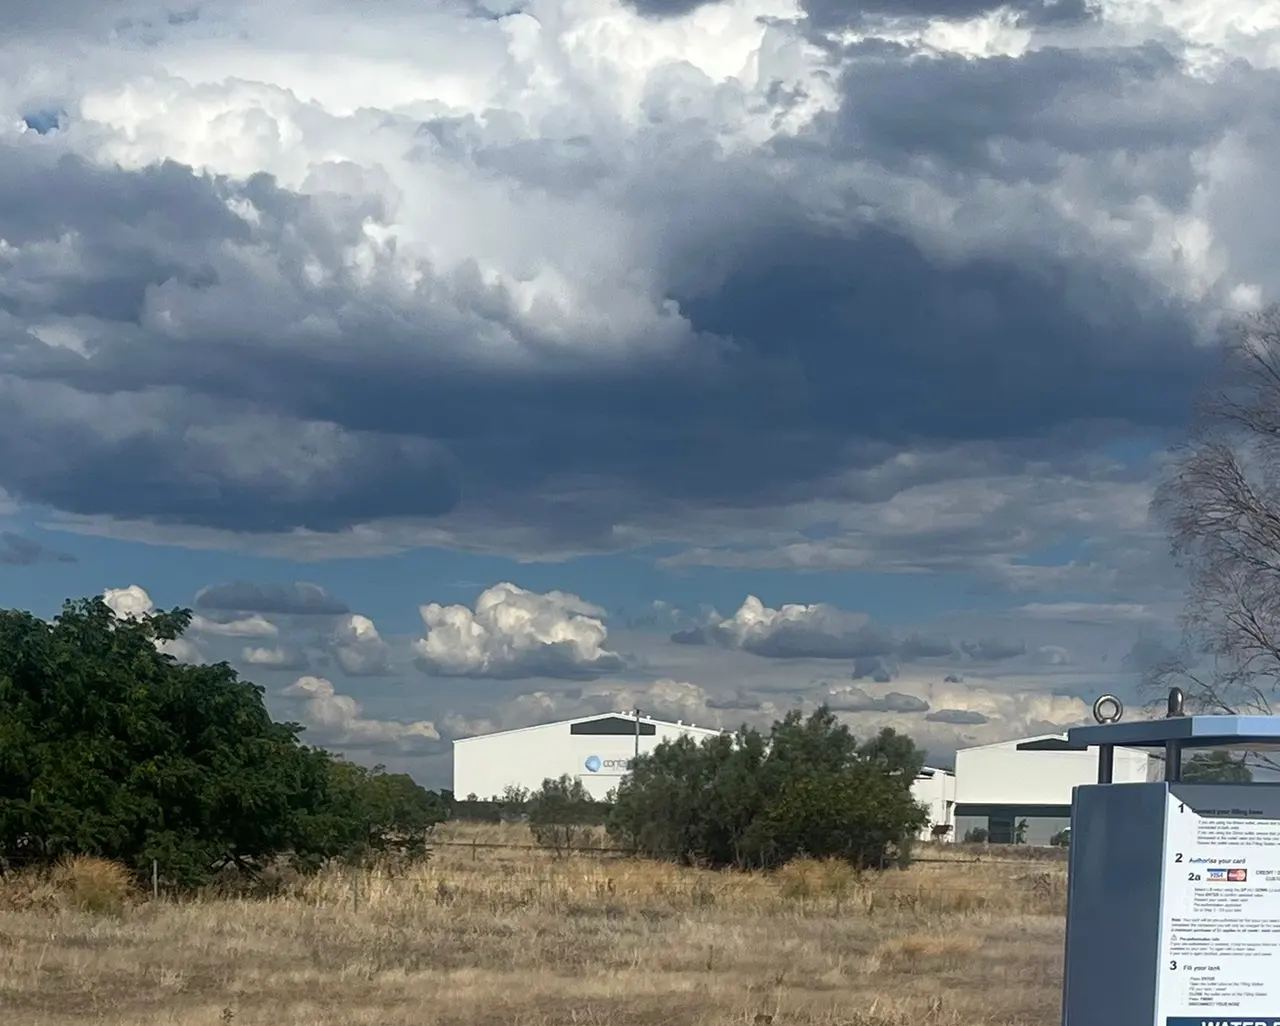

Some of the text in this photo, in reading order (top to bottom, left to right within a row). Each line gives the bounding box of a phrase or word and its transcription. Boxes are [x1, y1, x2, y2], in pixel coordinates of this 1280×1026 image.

[1177, 803, 1184, 813] 1
[1174, 853, 1183, 863] 2
[1188, 873, 1201, 881] 2a
[1169, 960, 1178, 971] 3
